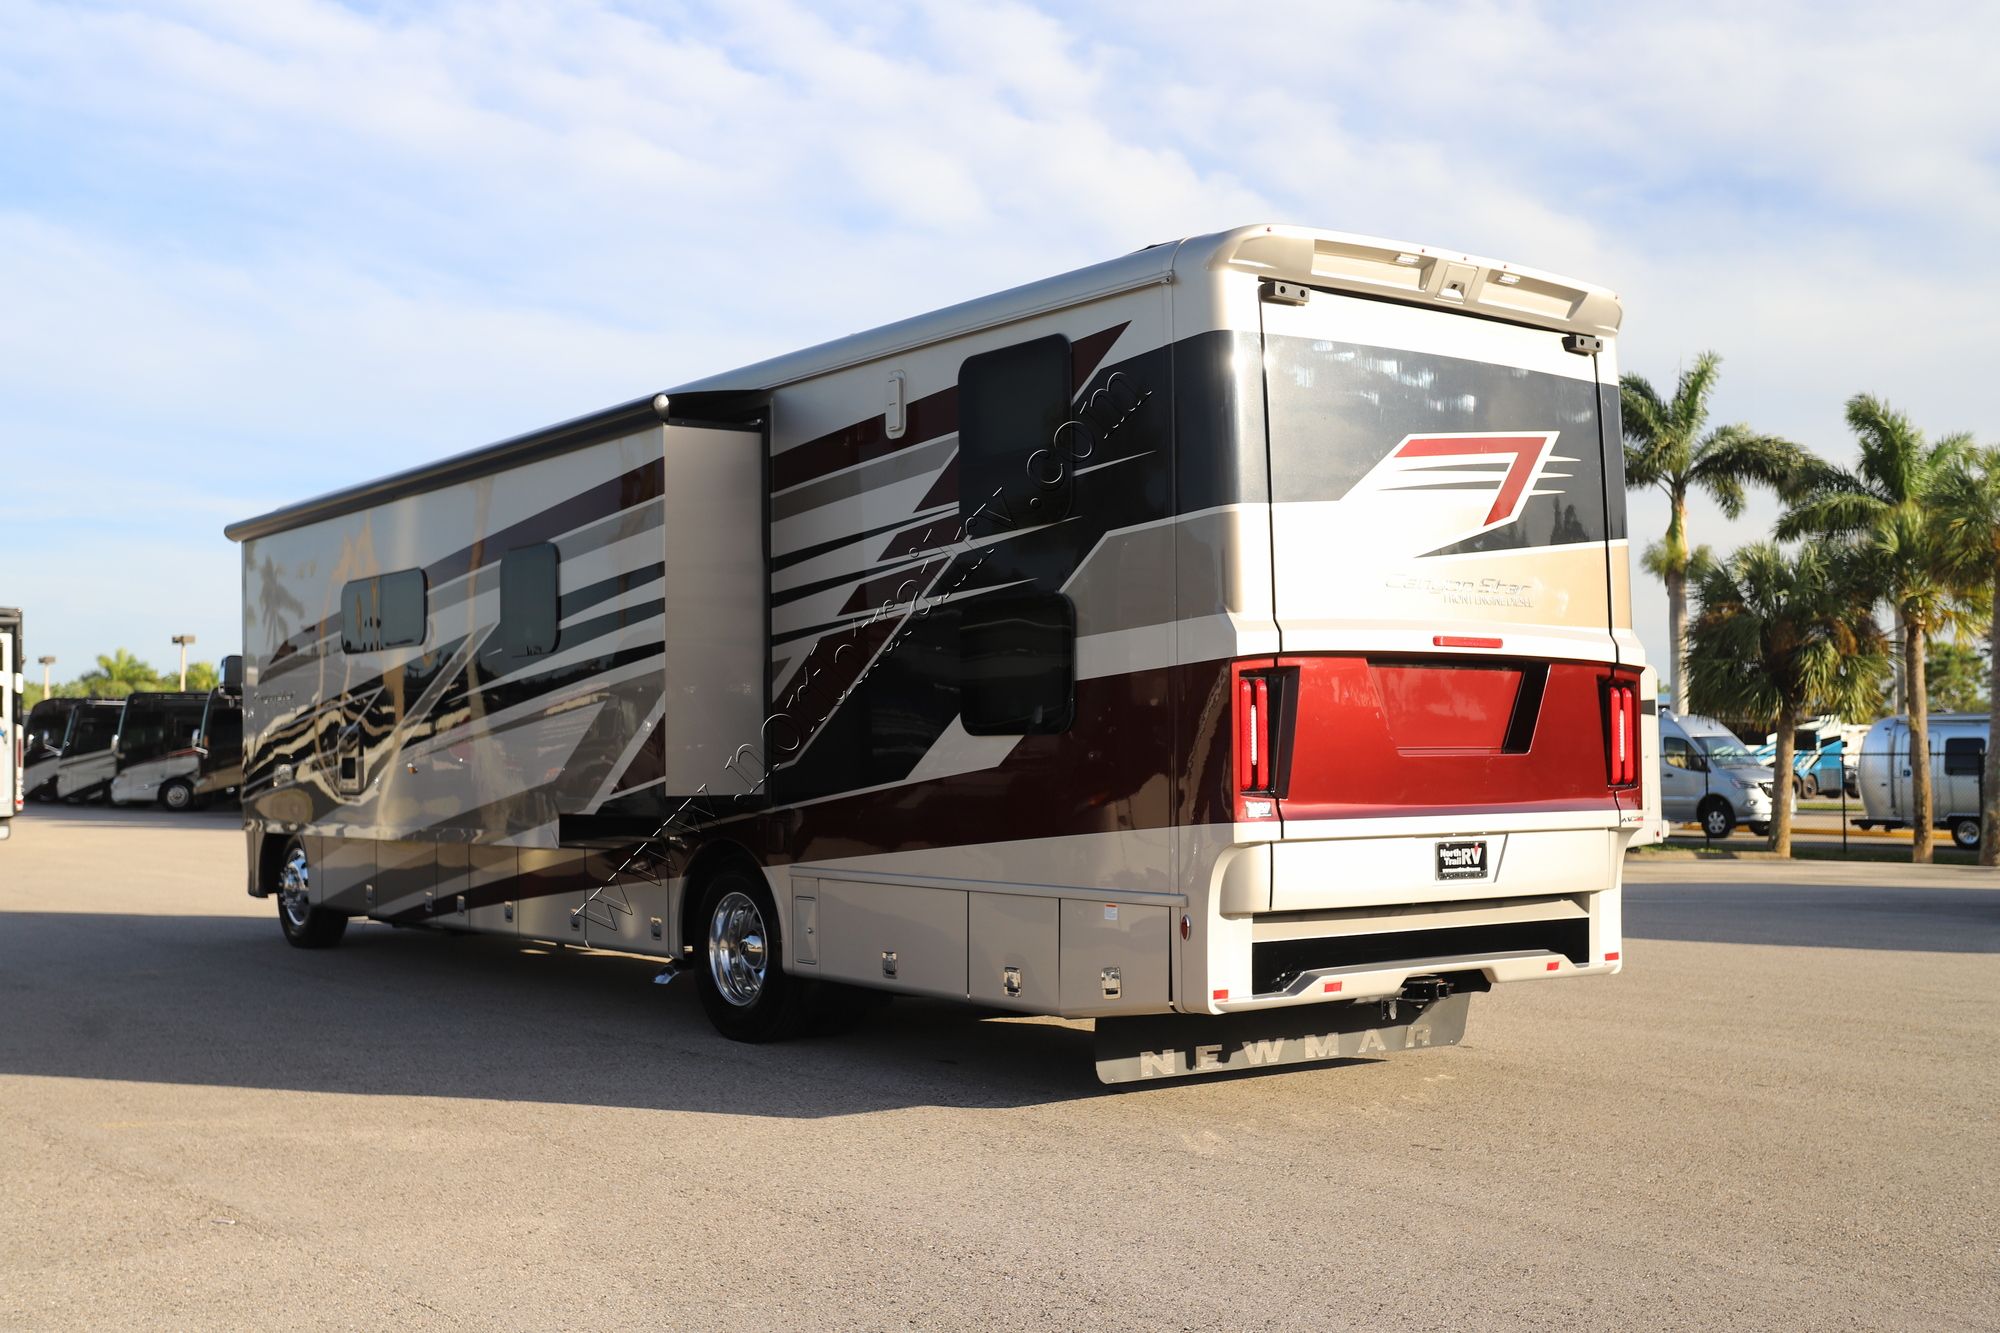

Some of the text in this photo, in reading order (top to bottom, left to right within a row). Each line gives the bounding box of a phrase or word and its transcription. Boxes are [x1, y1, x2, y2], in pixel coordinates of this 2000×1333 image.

[1477, 577, 1533, 595] Star
[1440, 848, 1462, 858] North
[1444, 857, 1462, 866] Trail
[1461, 847, 1482, 865] RV
[1139, 1023, 1431, 1078] NEWMAR
